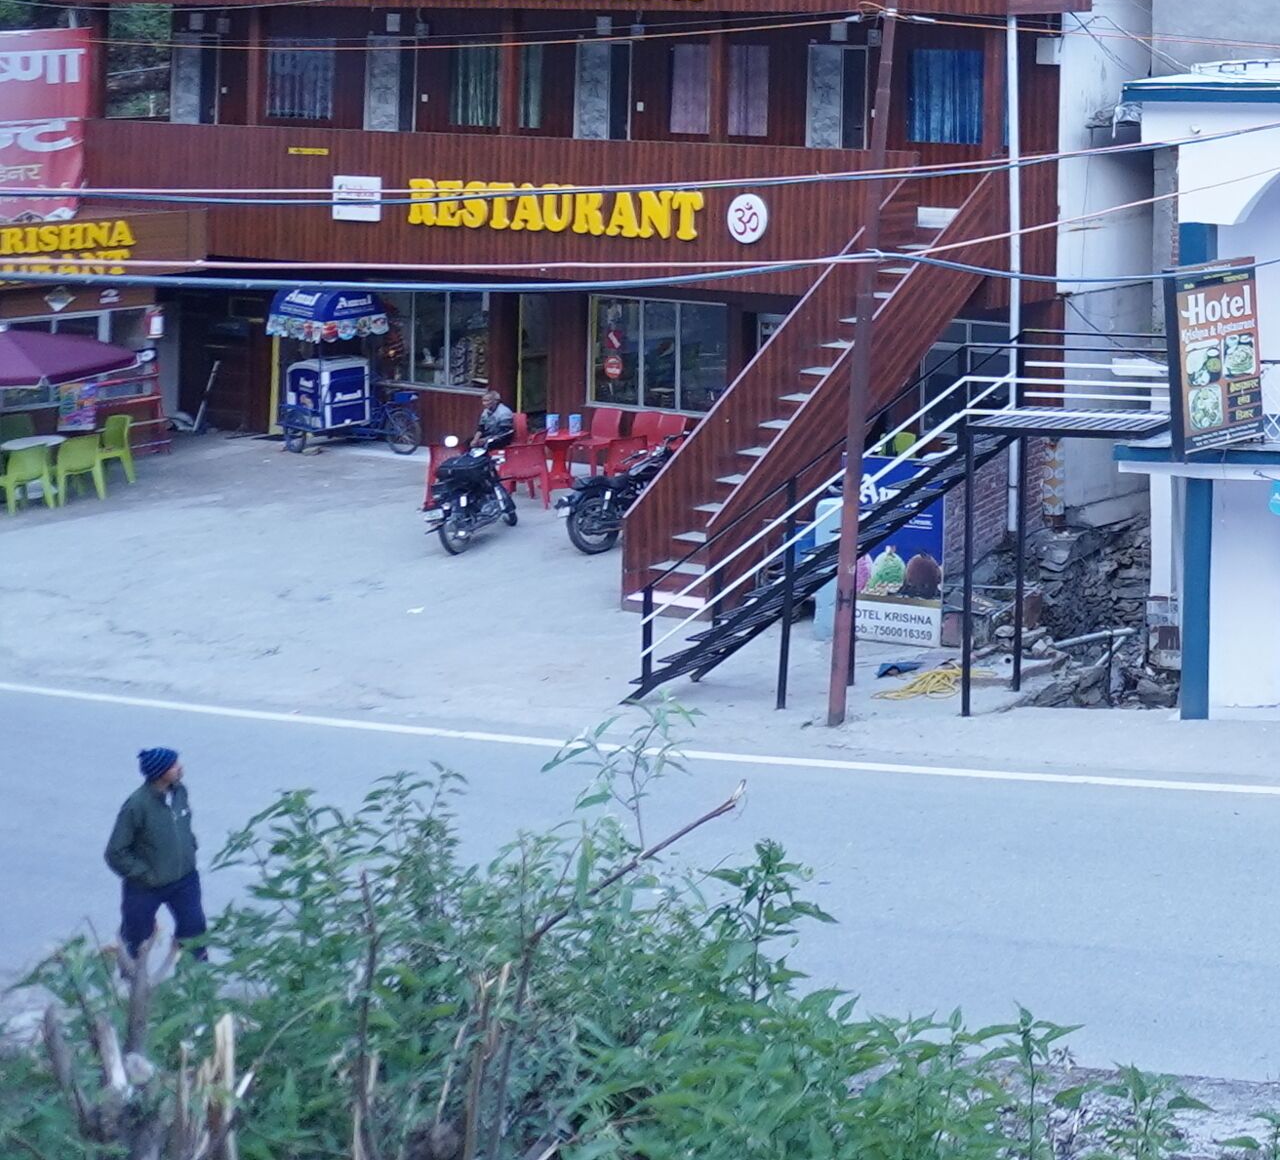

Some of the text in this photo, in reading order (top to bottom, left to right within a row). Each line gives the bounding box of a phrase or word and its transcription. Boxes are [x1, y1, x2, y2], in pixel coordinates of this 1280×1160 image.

[408, 178, 704, 241] RESTAURANT
[1181, 285, 1252, 326] Hotel
[855, 609, 934, 626] OTEL KRISHNA
